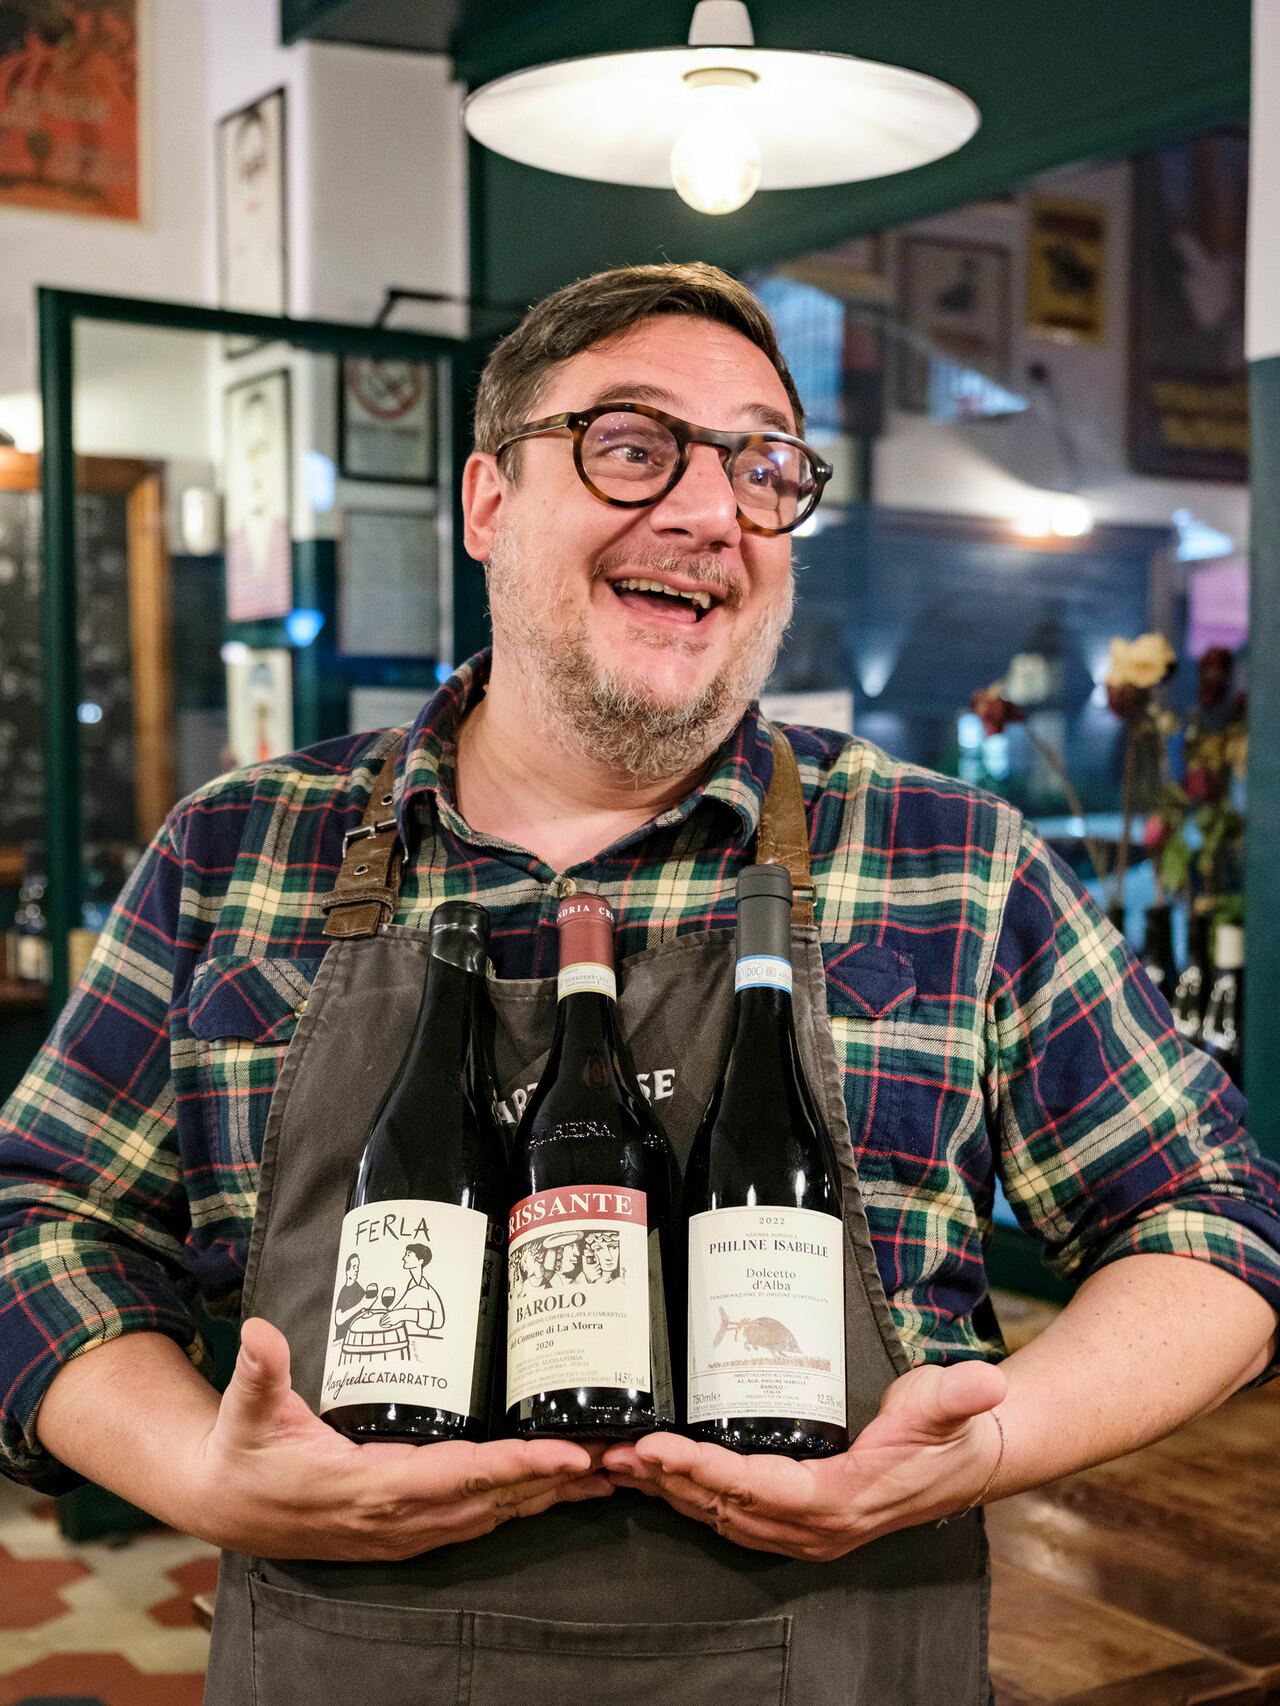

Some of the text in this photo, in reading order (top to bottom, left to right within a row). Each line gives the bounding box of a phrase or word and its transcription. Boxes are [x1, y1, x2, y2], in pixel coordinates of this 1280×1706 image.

[746, 966, 761, 977] DOC
[759, 1217, 785, 1225] 2022
[355, 1214, 431, 1246] FERLA
[709, 1239, 829, 1258] PHILINE ISABELLE
[746, 1268, 796, 1279] Dolcetto
[752, 1280, 791, 1291] d'Alba
[710, 1291, 756, 1301] DENOMINAZIONE
[516, 1292, 586, 1323] BAROLO
[545, 1312, 586, 1322] CONTROLLATA
[592, 1311, 627, 1319] GARANTITA
[517, 1330, 545, 1345] Comune
[546, 1325, 555, 1335] di
[557, 1324, 569, 1332] La
[572, 1321, 603, 1330] Morra
[536, 1340, 554, 1350] 2020
[542, 1355, 583, 1365] ALESSANDRIA
[323, 1366, 447, 1400] Manfredi CATARRATTO
